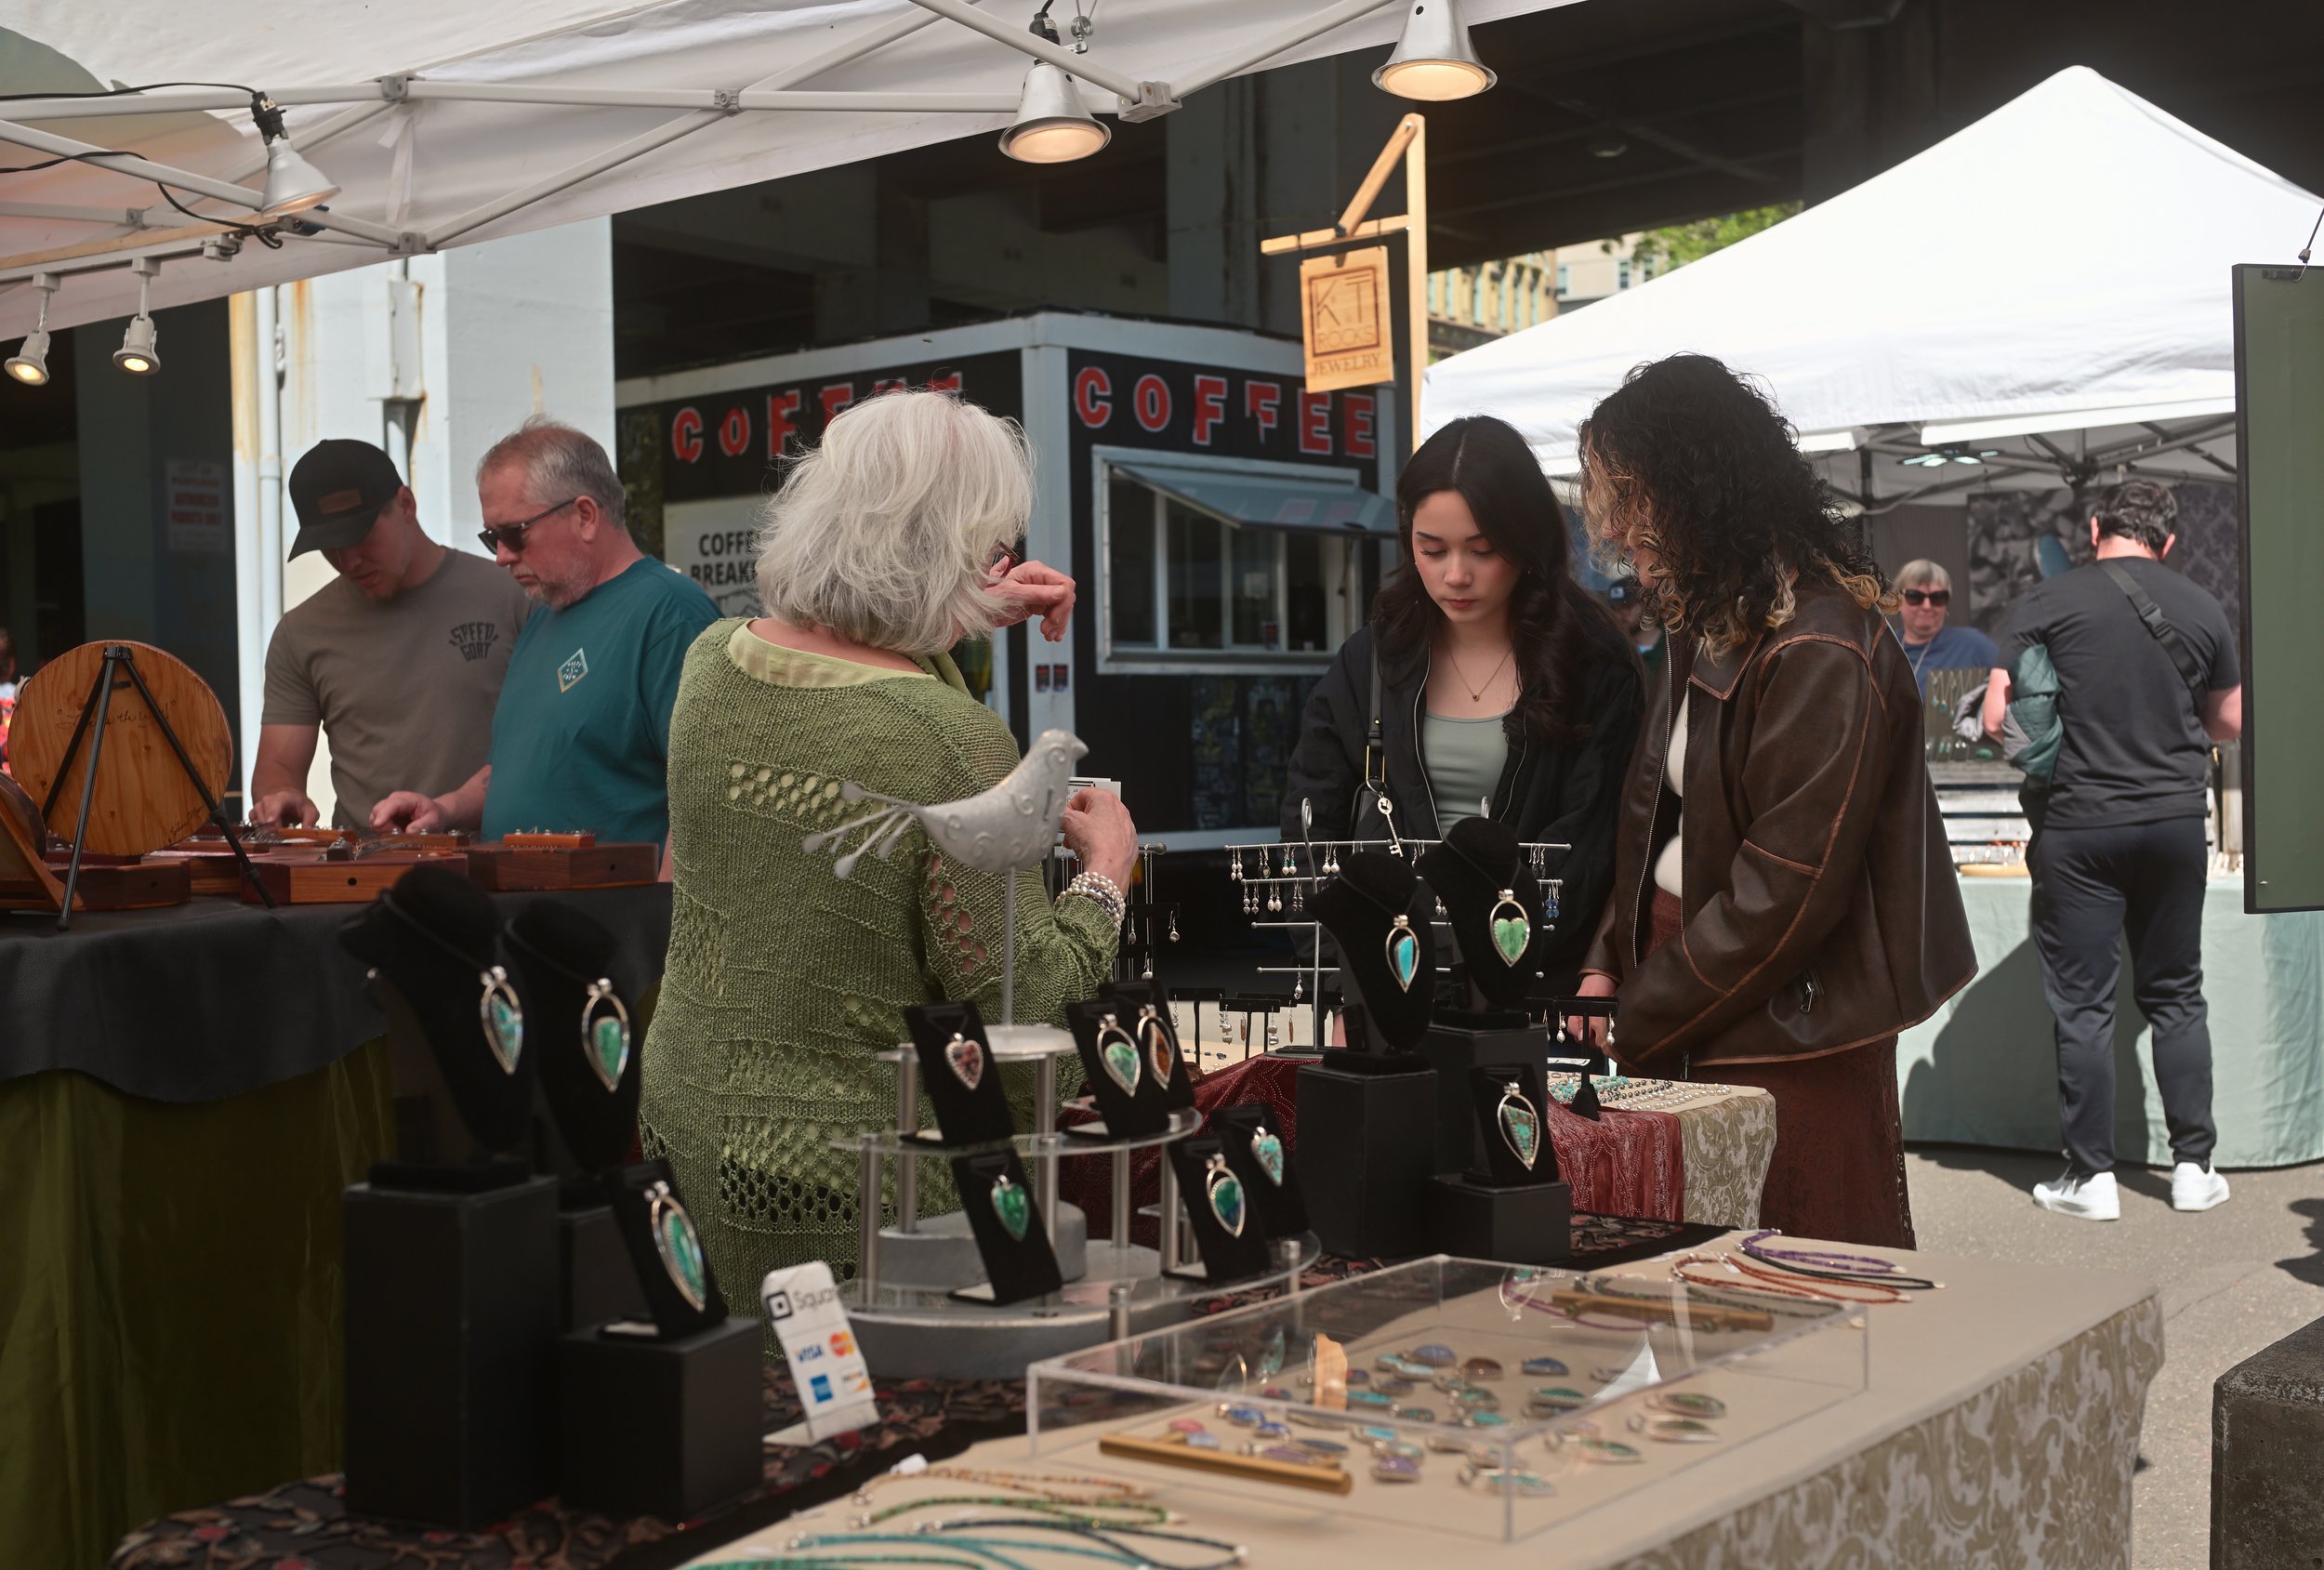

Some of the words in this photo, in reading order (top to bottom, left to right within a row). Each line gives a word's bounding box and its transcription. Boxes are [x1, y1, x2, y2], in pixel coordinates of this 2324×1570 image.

[1316, 325, 1376, 349] ROCKS
[1311, 353, 1382, 376] JEWELRY
[1073, 365, 1377, 459] COFFEE
[449, 621, 496, 644] SPEED
[459, 641, 492, 662] GOAT
